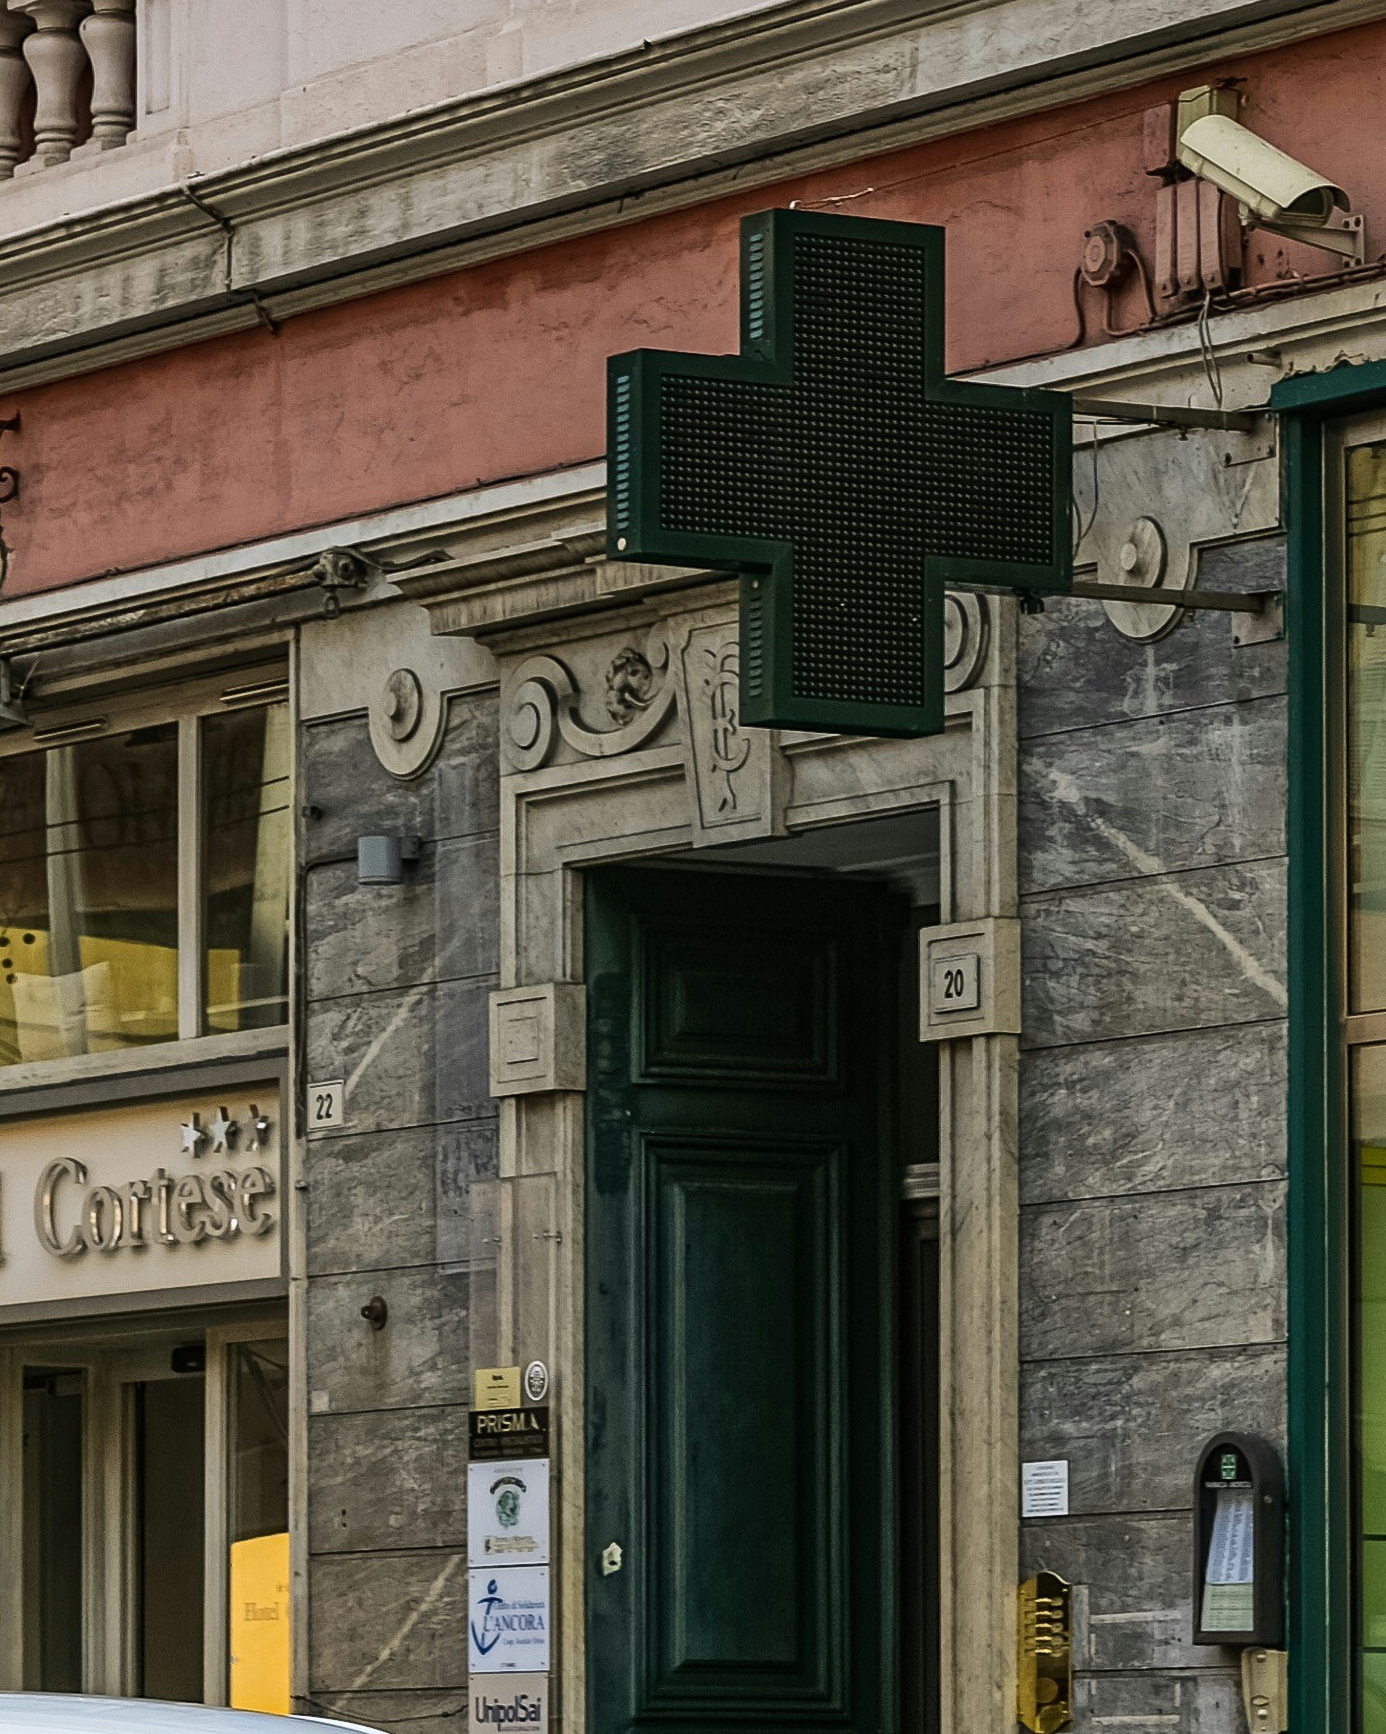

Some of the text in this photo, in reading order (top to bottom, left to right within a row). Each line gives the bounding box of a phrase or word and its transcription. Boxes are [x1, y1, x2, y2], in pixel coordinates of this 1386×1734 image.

[943, 967, 965, 999] 20
[316, 1092, 333, 1121] 22
[33, 1155, 277, 1259] Cortese
[475, 1693, 542, 1732] UnipolSai
